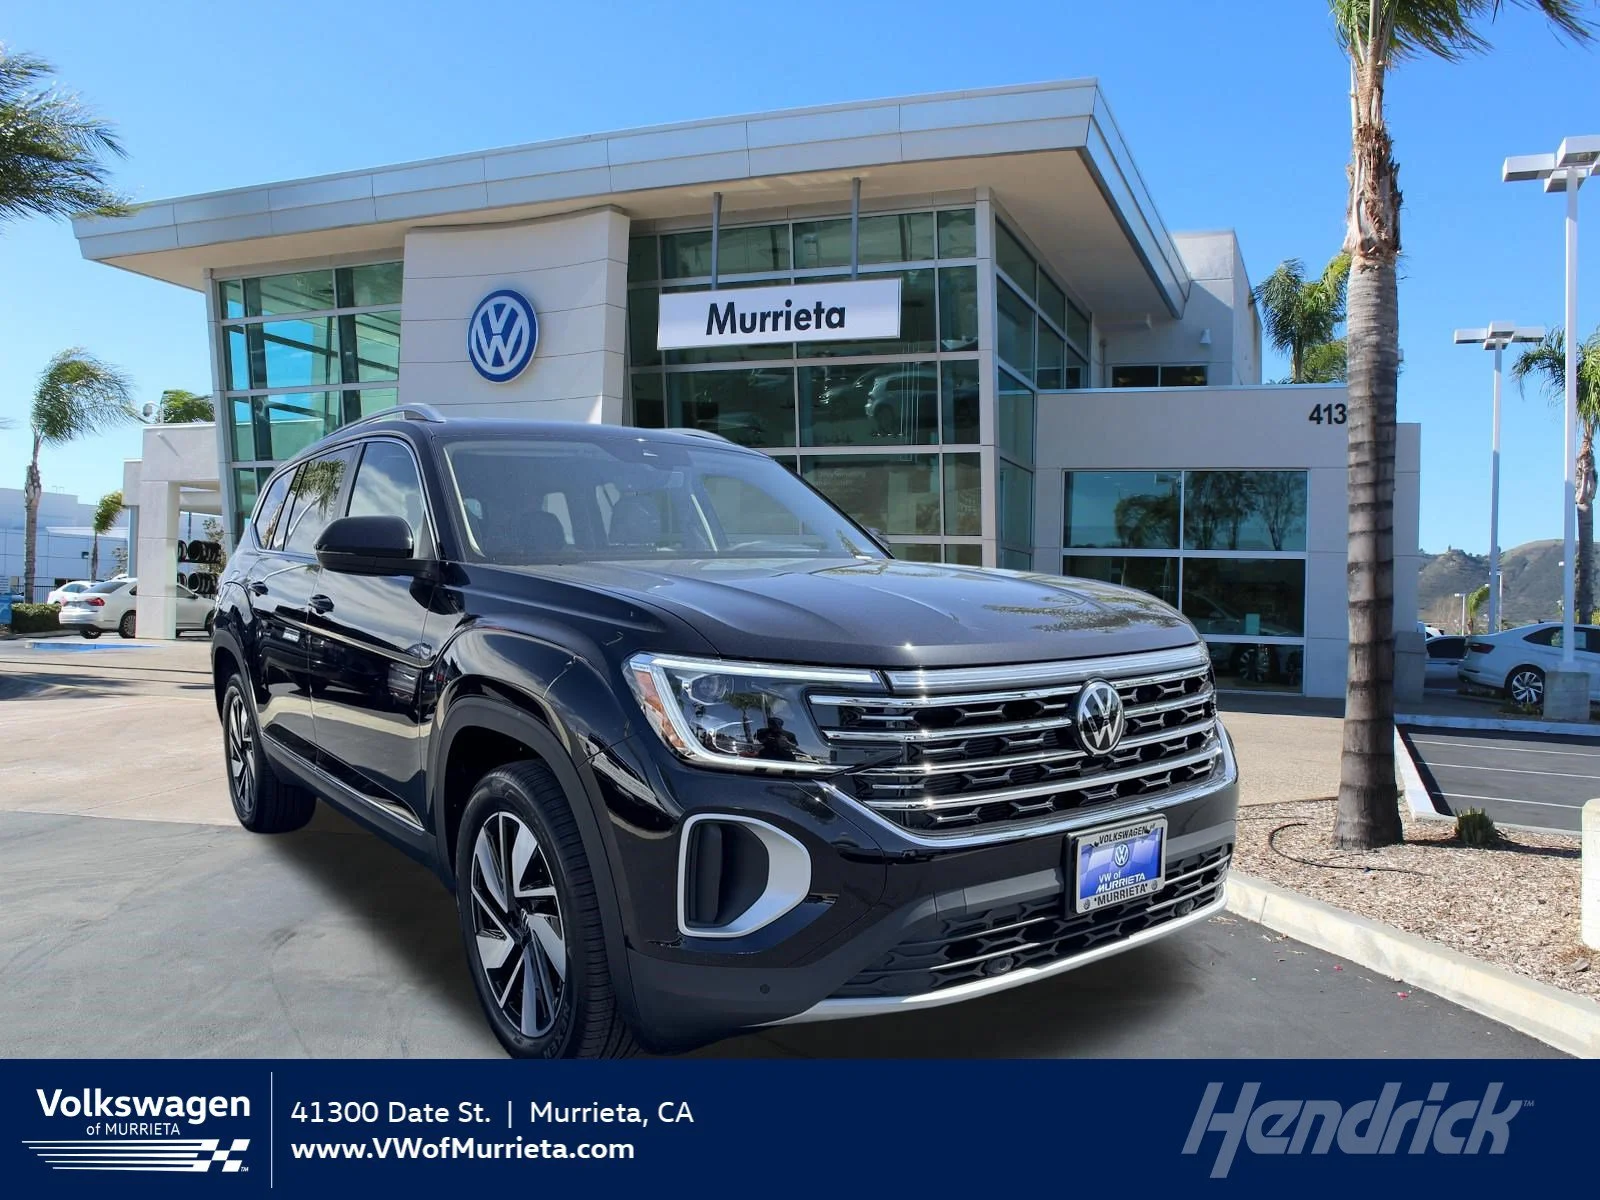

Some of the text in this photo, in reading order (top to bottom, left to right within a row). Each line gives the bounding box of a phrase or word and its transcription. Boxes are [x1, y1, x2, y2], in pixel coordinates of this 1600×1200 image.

[706, 299, 846, 336] Murrieta
[1095, 872, 1146, 894] MURRIETA
[1098, 872, 1112, 883] VW
